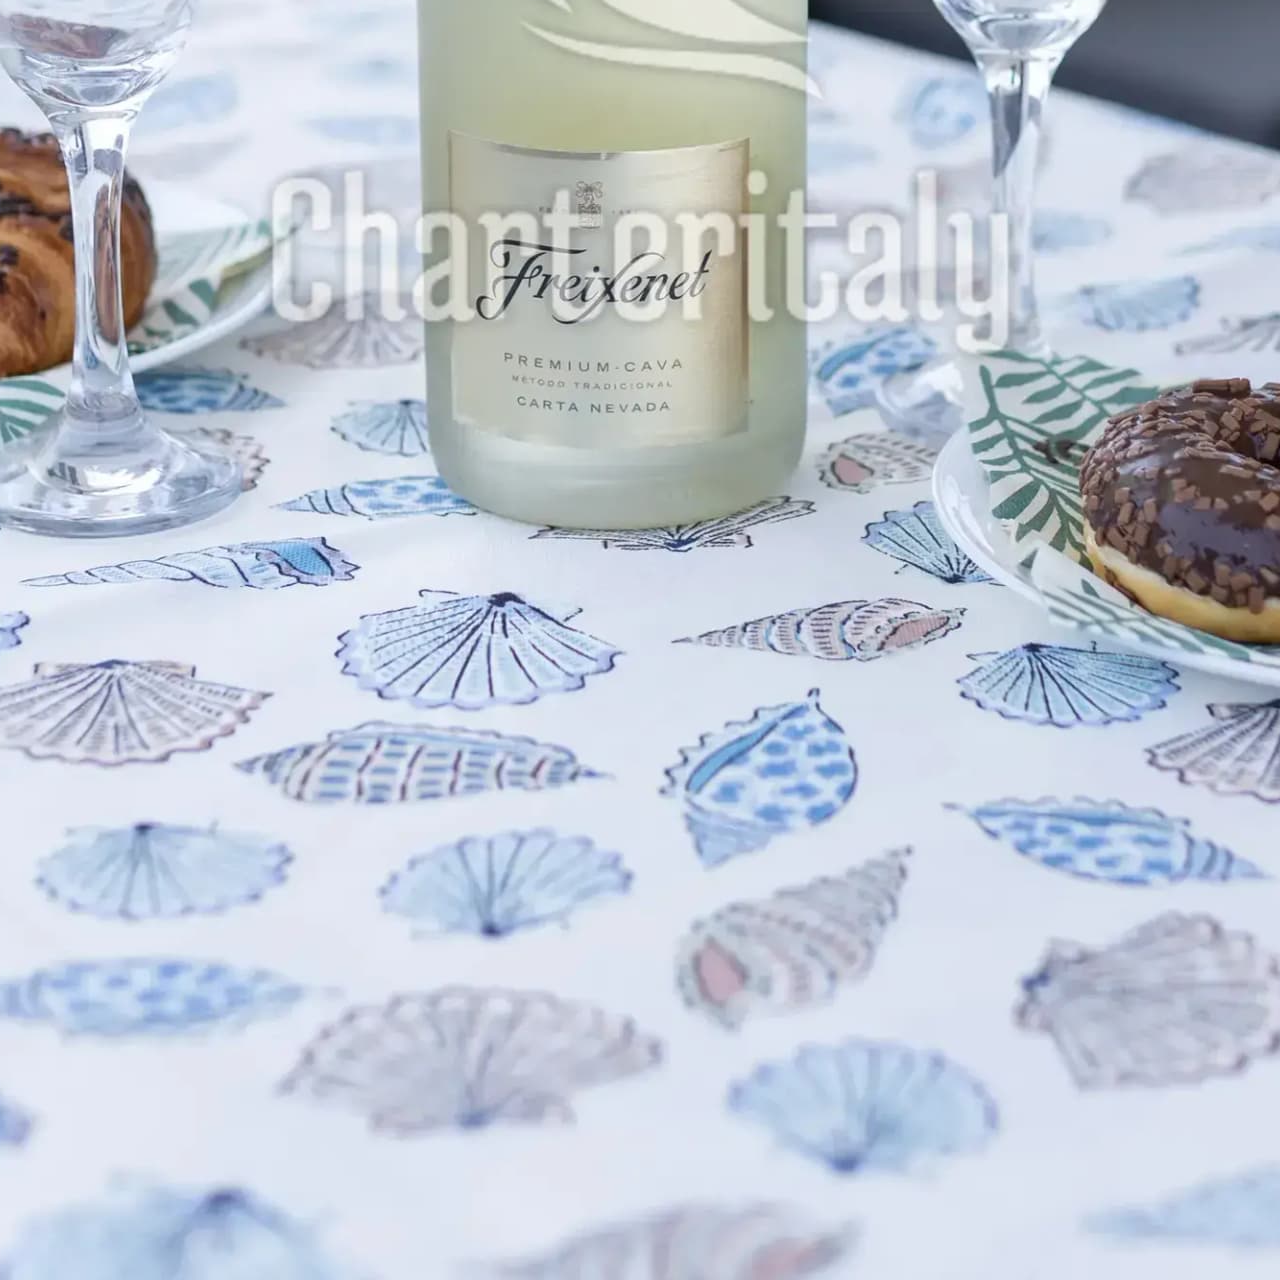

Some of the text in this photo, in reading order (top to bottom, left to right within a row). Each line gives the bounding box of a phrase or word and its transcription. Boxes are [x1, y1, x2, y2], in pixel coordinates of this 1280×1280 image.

[476, 238, 712, 325] Freixenet
[573, 381, 673, 391] TRADICIONAL
[516, 396, 671, 414] CARTA NEVADA
